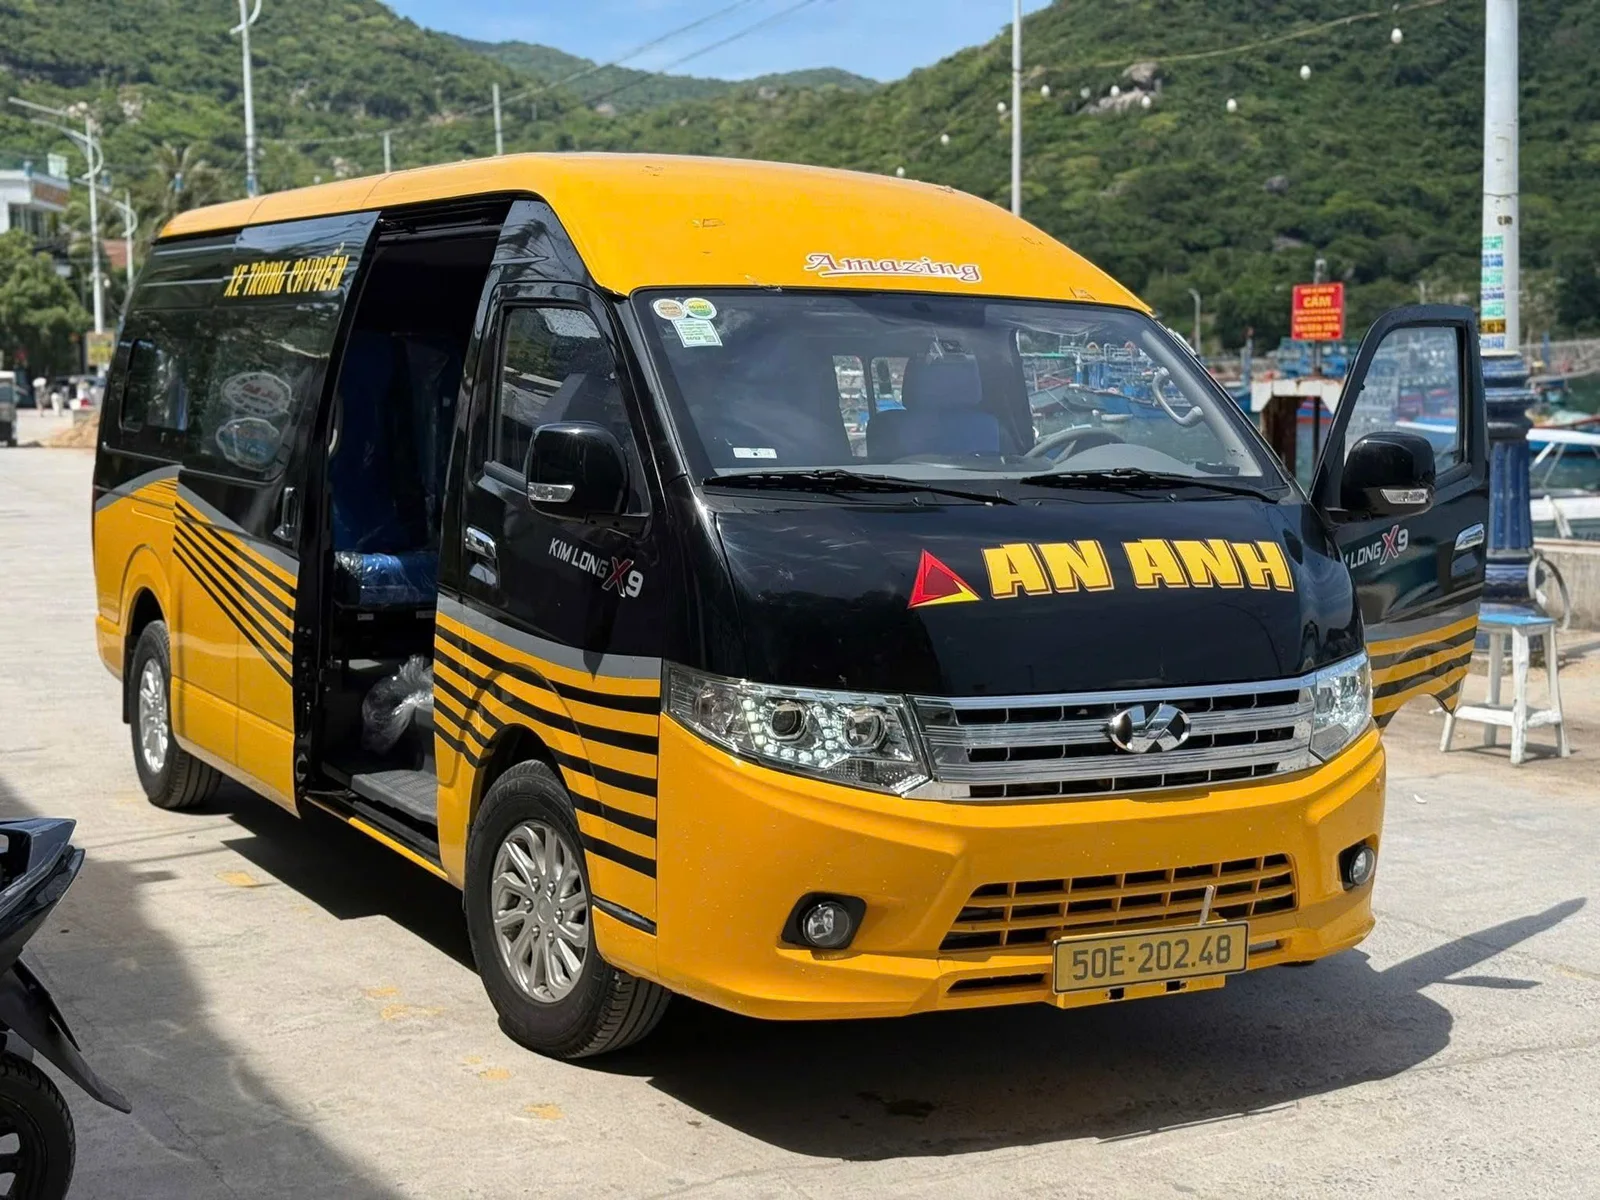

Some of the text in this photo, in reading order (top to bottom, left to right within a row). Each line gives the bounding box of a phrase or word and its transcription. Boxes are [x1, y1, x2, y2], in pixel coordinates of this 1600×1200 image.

[223, 241, 351, 297] XE TRUNG CHUYỂN
[804, 252, 982, 284] Amazing
[548, 537, 644, 598] KIM LONG X9
[982, 538, 1295, 600] AN ANH
[1350, 524, 1408, 569] LONG X9
[1072, 934, 1233, 981] 50E-202.48
